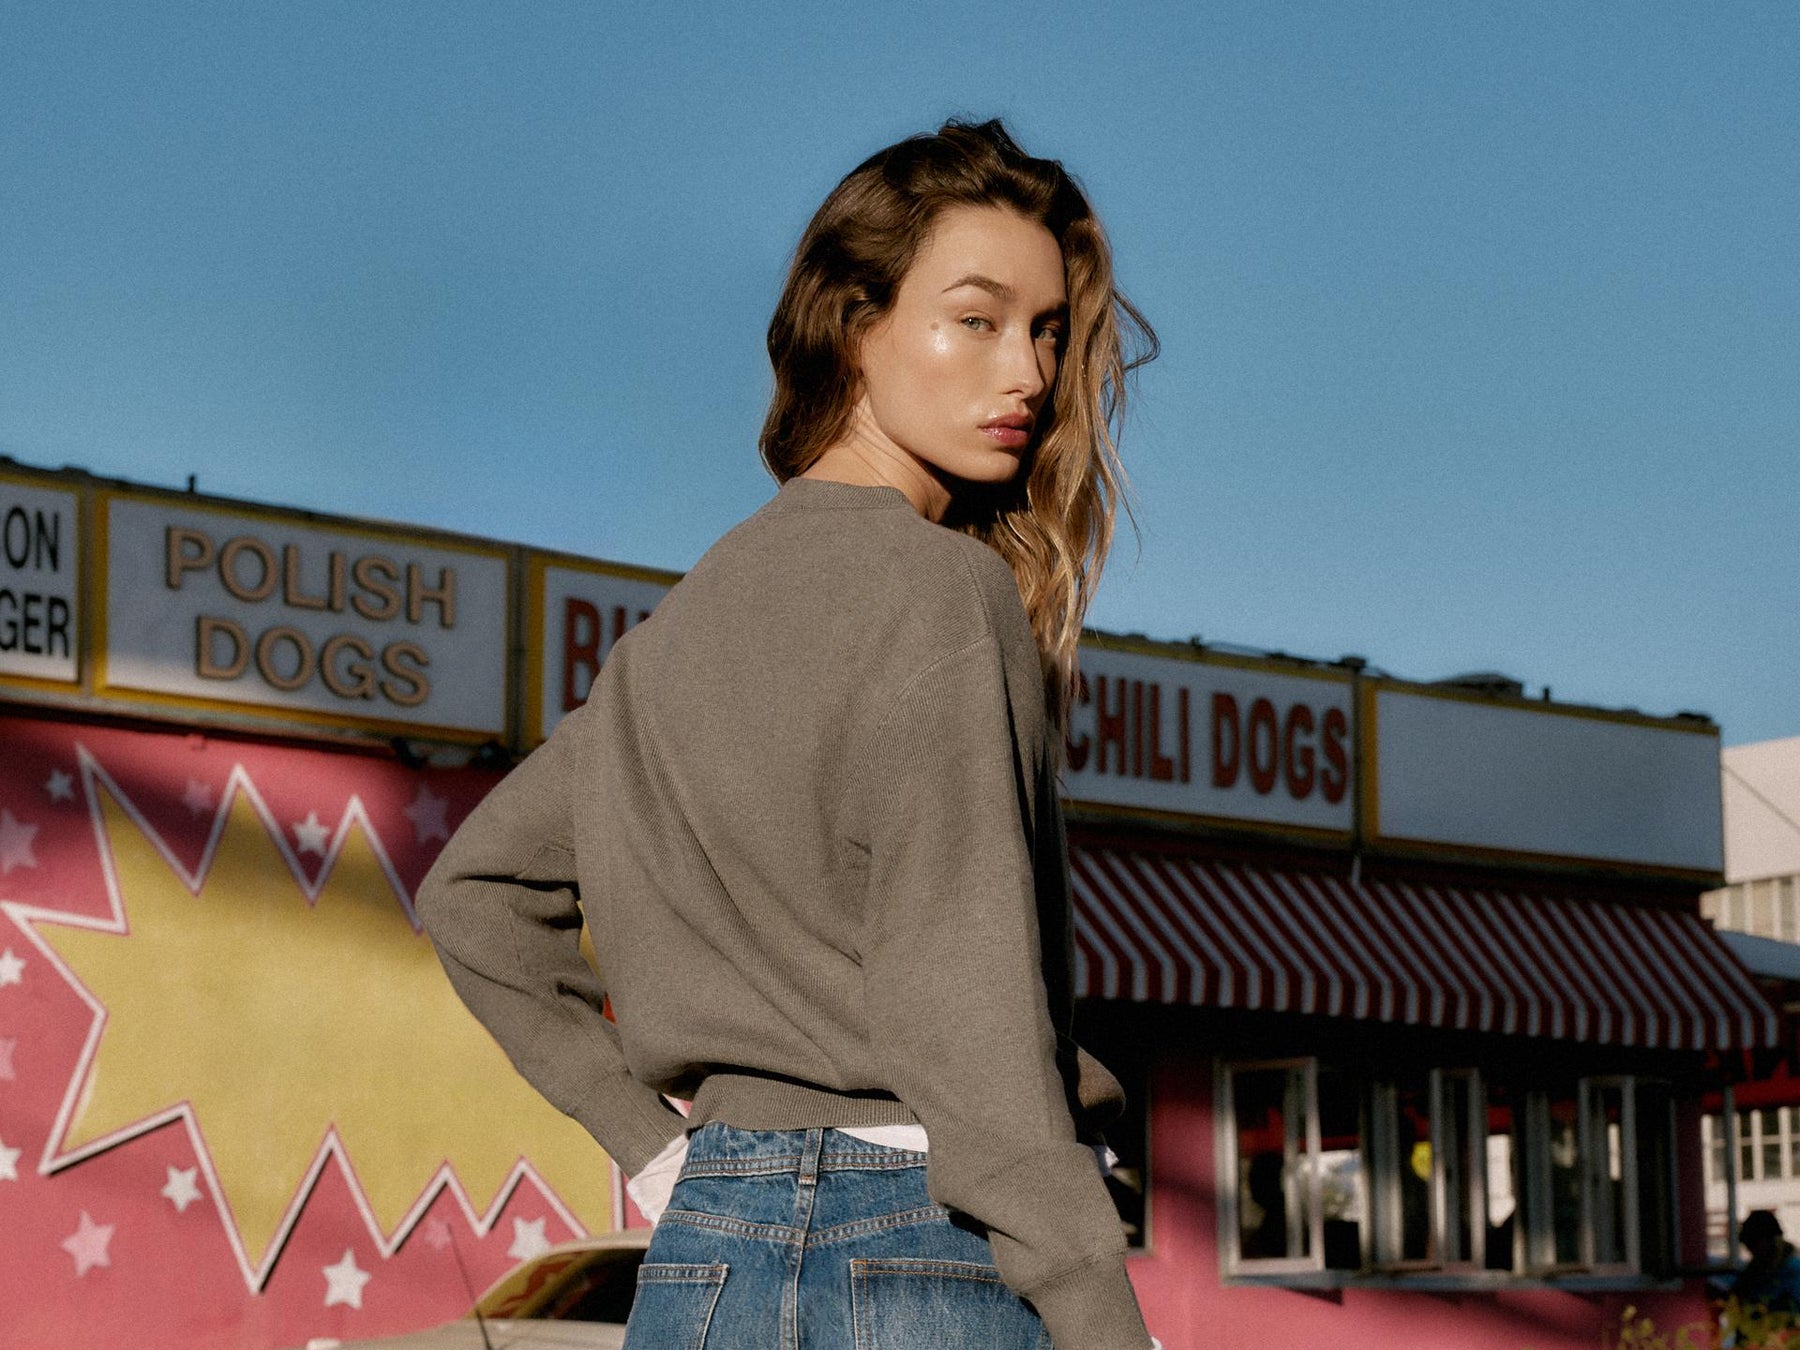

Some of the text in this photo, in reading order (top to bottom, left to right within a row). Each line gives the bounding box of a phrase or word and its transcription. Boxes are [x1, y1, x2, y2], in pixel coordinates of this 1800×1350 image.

[4, 506, 60, 572] ON
[165, 524, 457, 629] POLISH
[196, 616, 431, 707] DOGS
[1211, 692, 1349, 804] DOGS
